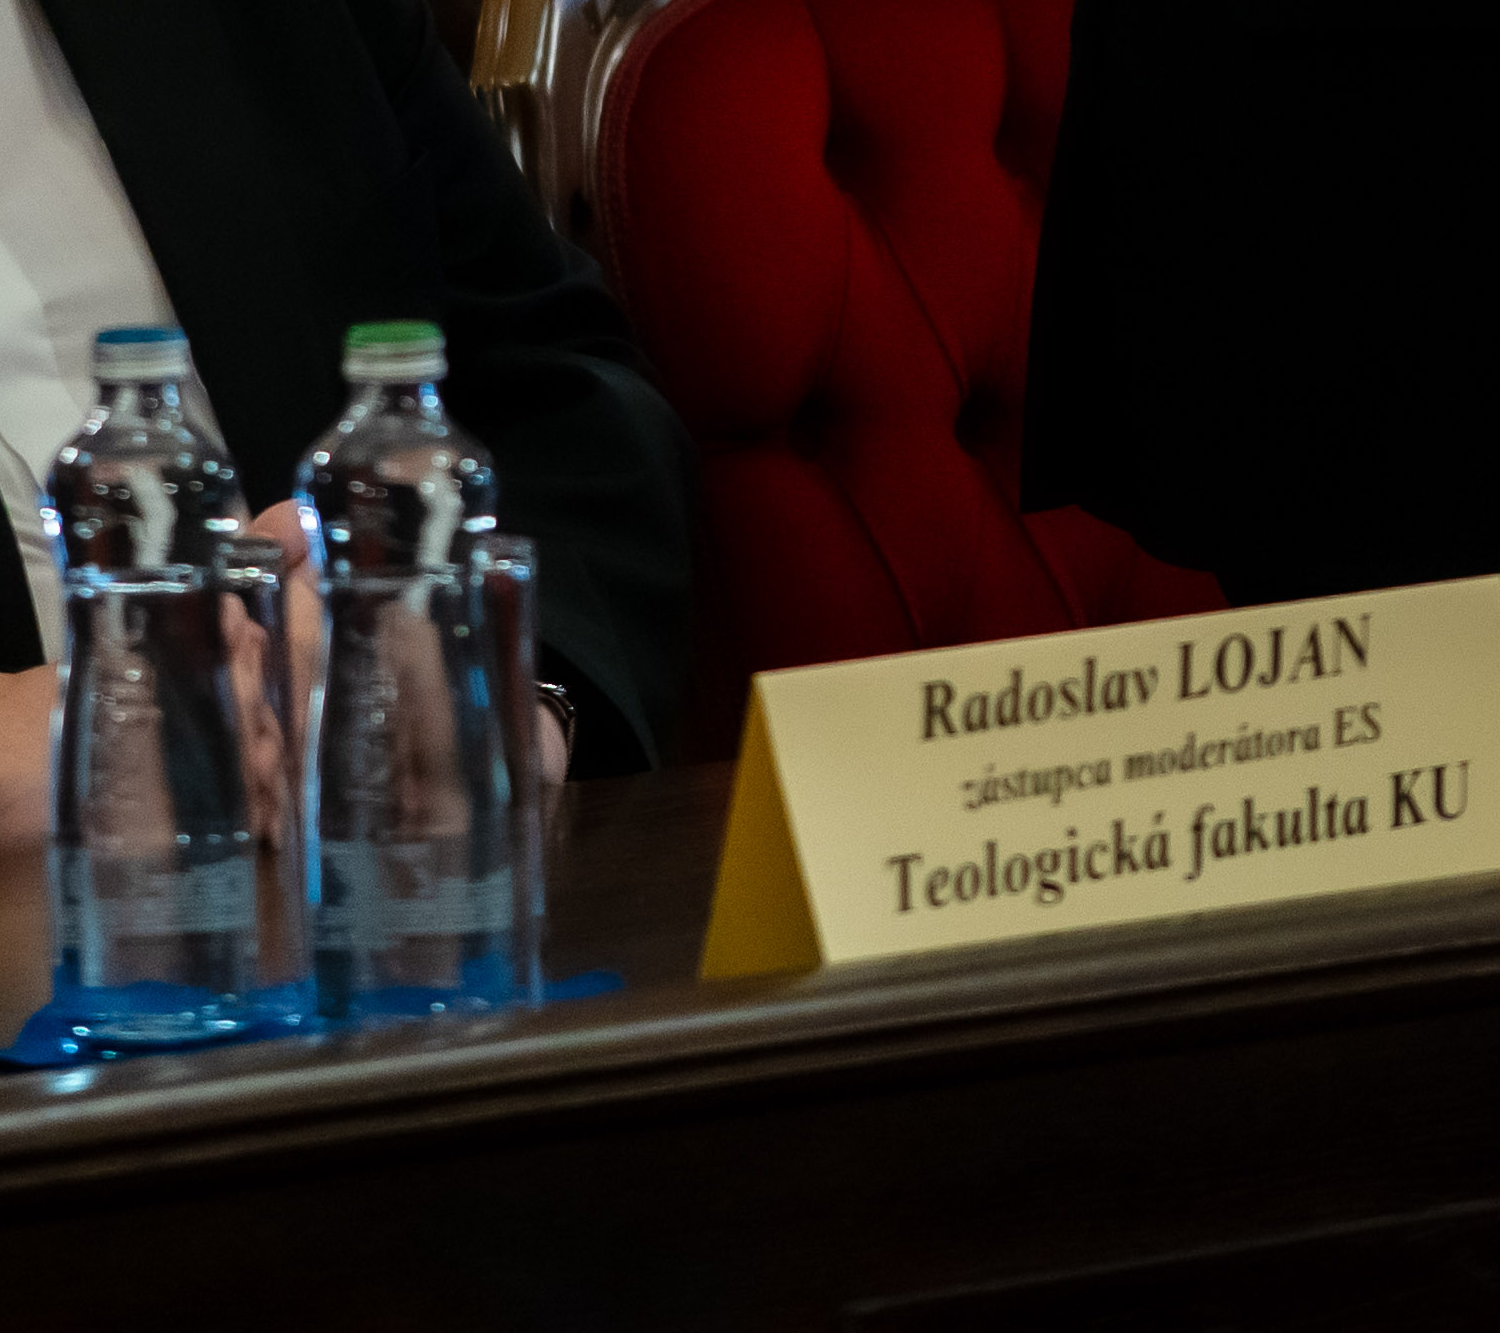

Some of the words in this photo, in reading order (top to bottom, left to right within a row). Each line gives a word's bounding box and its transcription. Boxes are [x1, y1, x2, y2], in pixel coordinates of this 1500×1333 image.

[919, 658, 1159, 743] Radoslav
[1178, 613, 1374, 702] LOJAN
[962, 748, 1111, 810] zástupca
[1123, 721, 1320, 783] moderátora
[1333, 702, 1383, 747] ES
[886, 812, 1171, 914] Teologická
[1187, 787, 1369, 881] fakulta
[1388, 760, 1471, 828] KU
